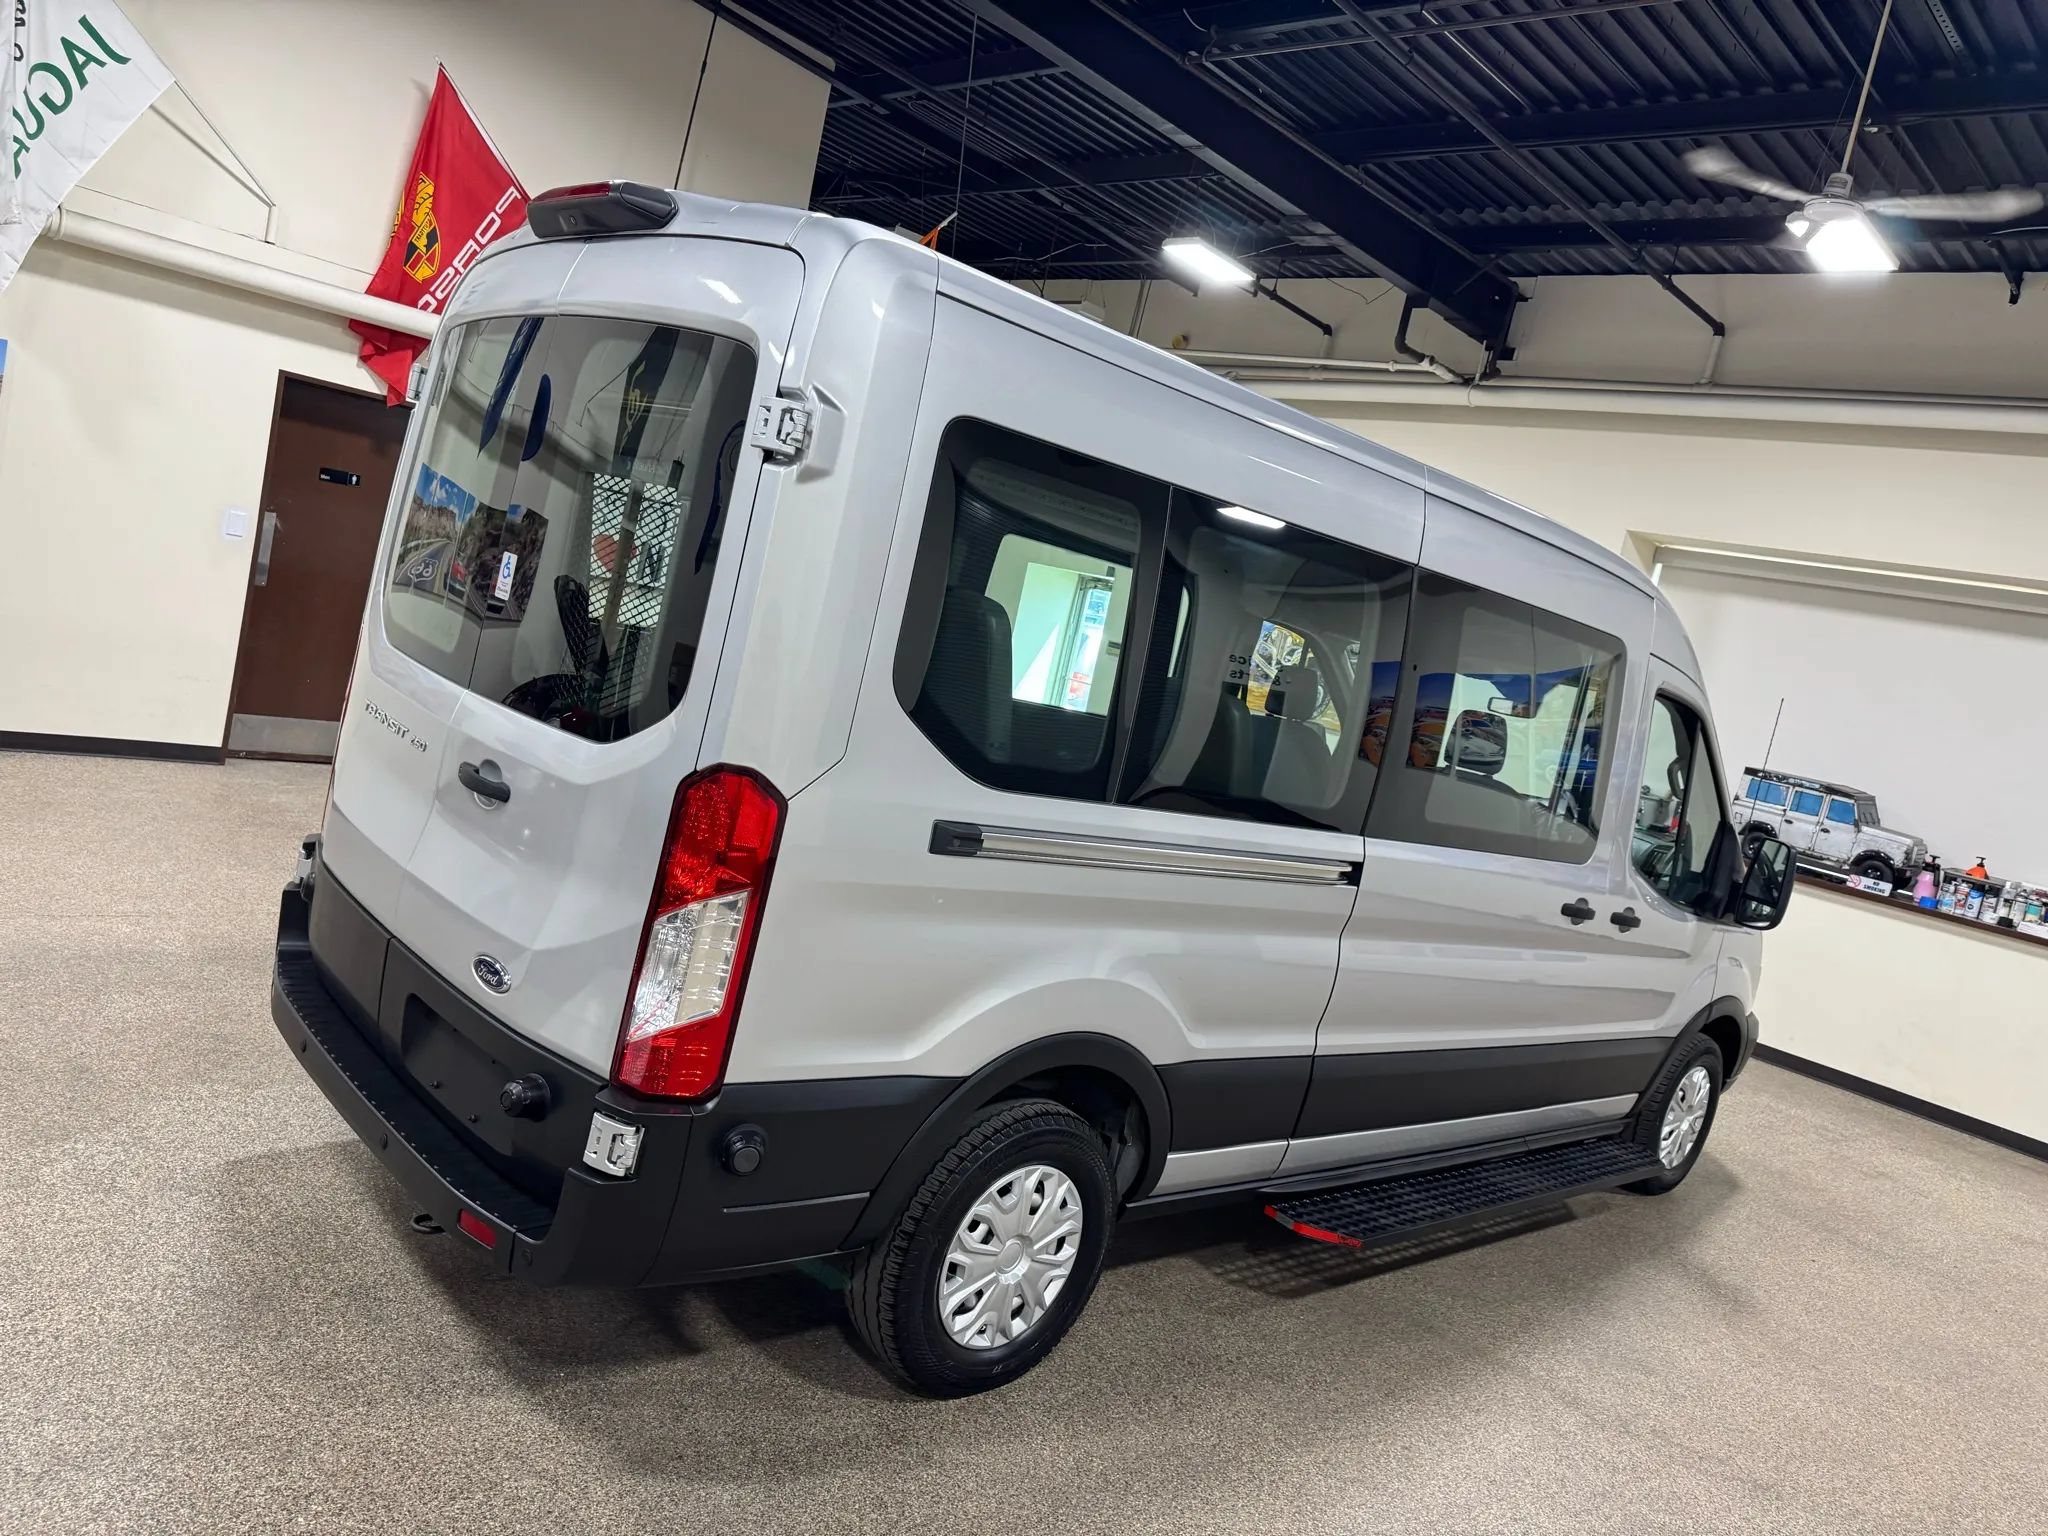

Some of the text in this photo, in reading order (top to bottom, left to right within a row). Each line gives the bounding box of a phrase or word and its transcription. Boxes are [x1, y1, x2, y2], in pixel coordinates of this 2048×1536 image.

[364, 698, 429, 753] TRANSIT 250
[1863, 884, 1887, 894] SMOKING
[477, 961, 500, 986] Ford
